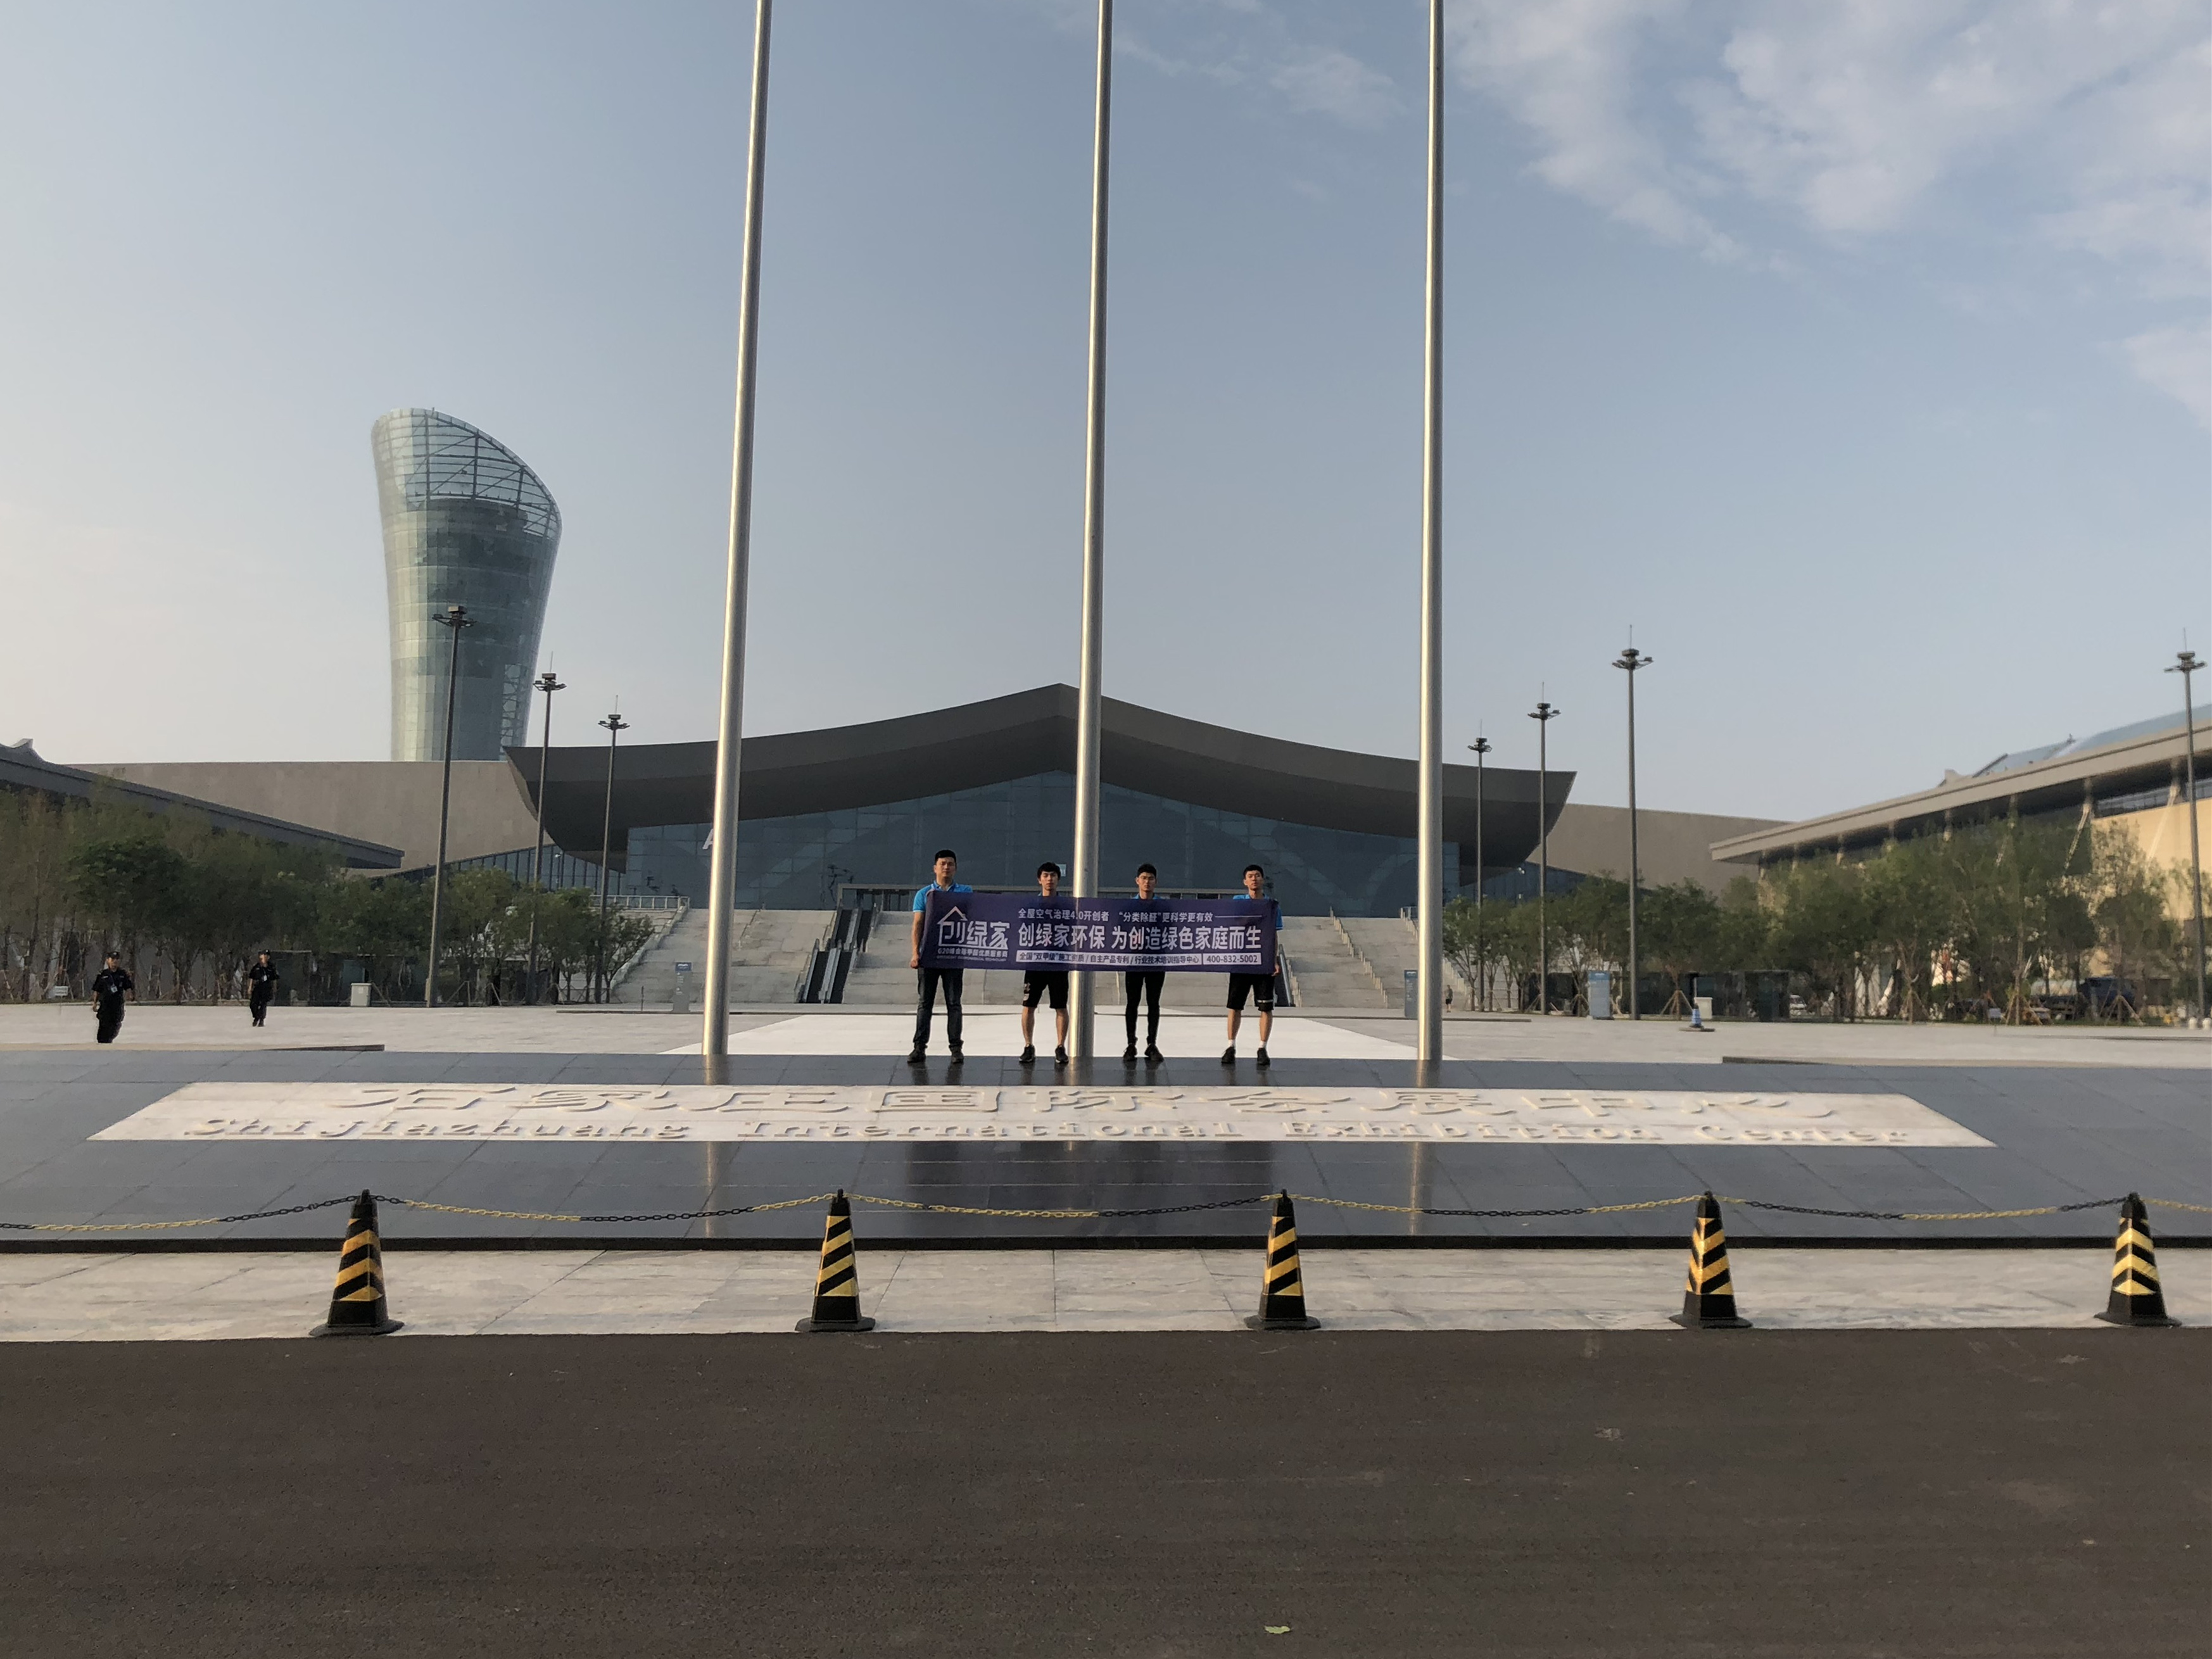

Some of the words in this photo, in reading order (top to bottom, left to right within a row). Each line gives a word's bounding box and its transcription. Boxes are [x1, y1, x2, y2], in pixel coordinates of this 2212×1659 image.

[1018, 908, 1109, 921] 全屋空气治理4.0开创者
[1018, 923, 1105, 949] 创绿家环保
[1111, 925, 1261, 950] 为创造绿色家庭而生
[1206, 954, 1258, 964] 400-832-5002
[323, 1086, 1838, 1118] 石家庄国际会展中心
[736, 1121, 1244, 1138] International
[1284, 1121, 1664, 1140] Exhibition
[1695, 1125, 1908, 1142] Center
